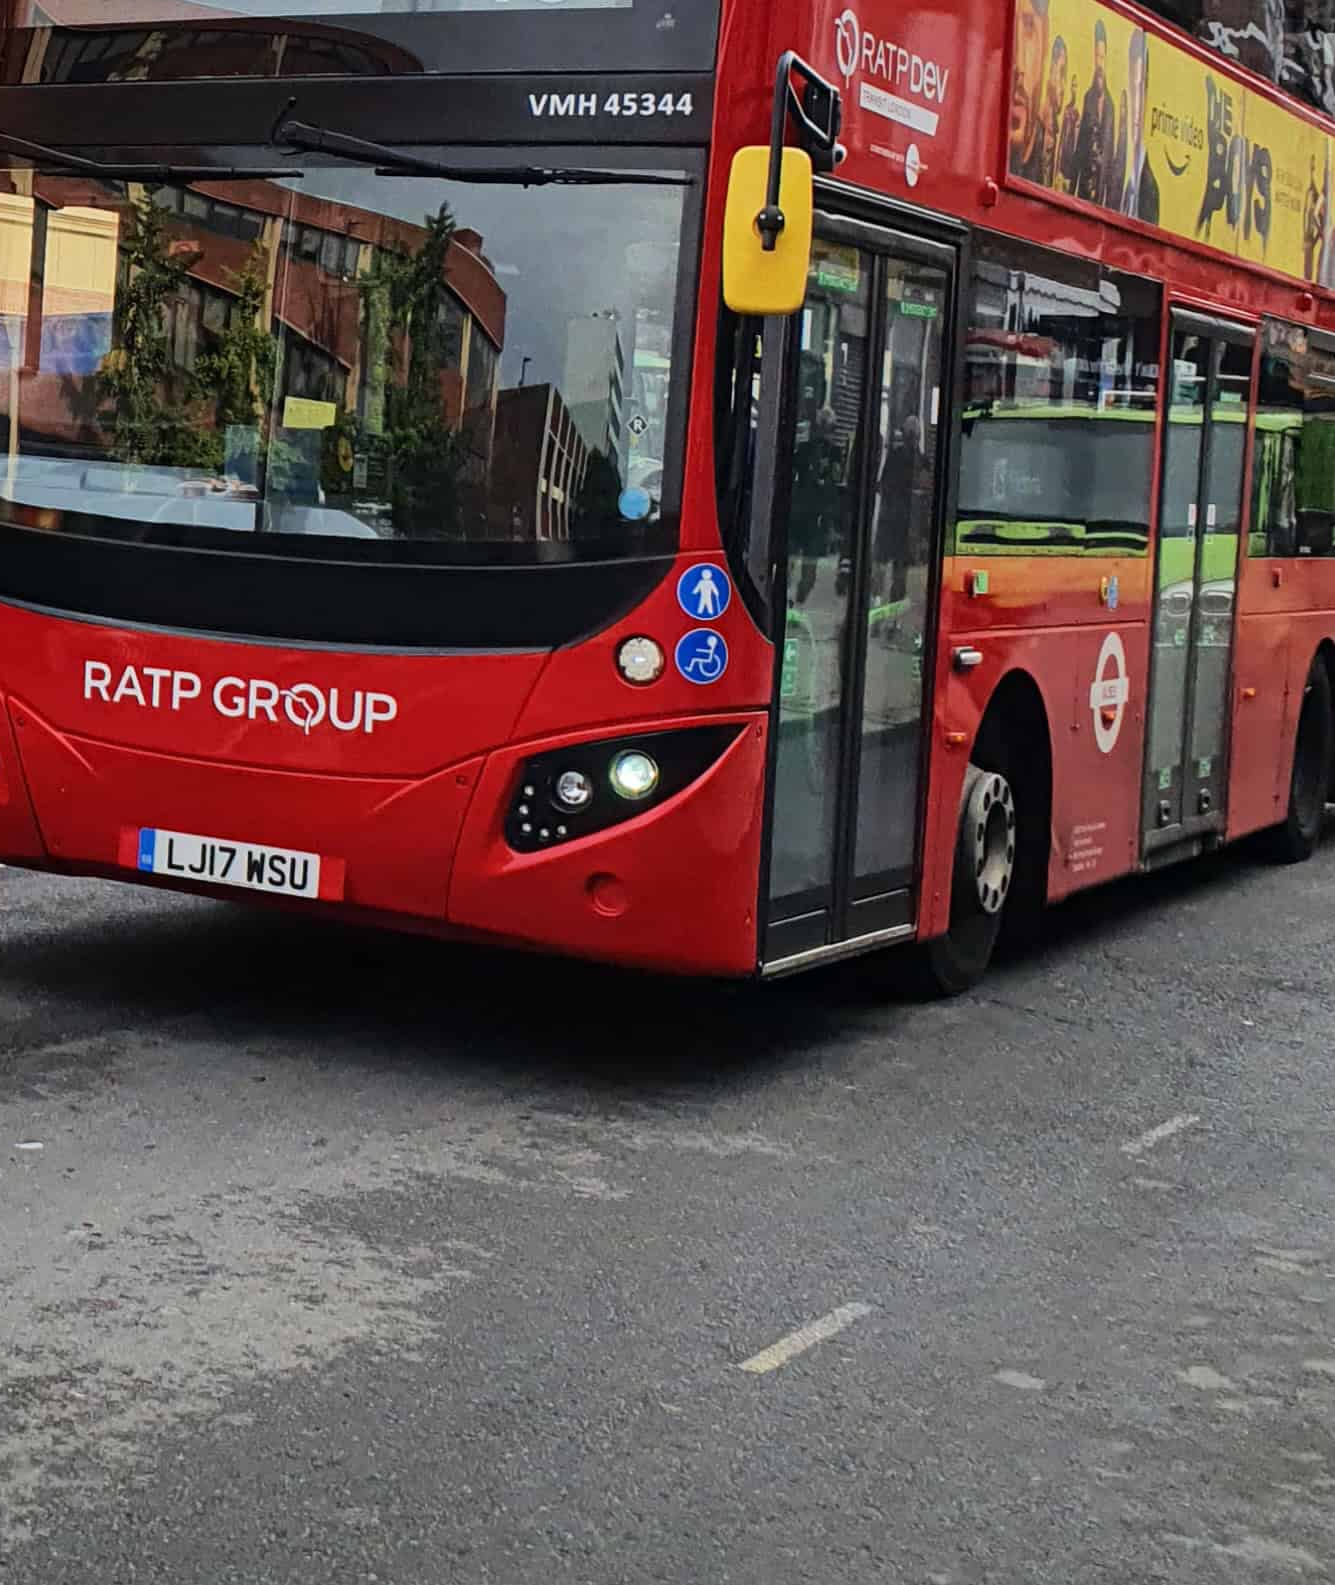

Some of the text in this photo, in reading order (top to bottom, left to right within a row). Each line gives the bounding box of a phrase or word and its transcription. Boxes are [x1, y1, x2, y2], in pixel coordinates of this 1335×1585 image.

[529, 93, 693, 116] VMH 45344
[1150, 102, 1204, 151] prime video
[1197, 130, 1273, 248] BOYS
[84, 661, 397, 735] RATP GROUP
[167, 838, 308, 890] LJ17 WSU
